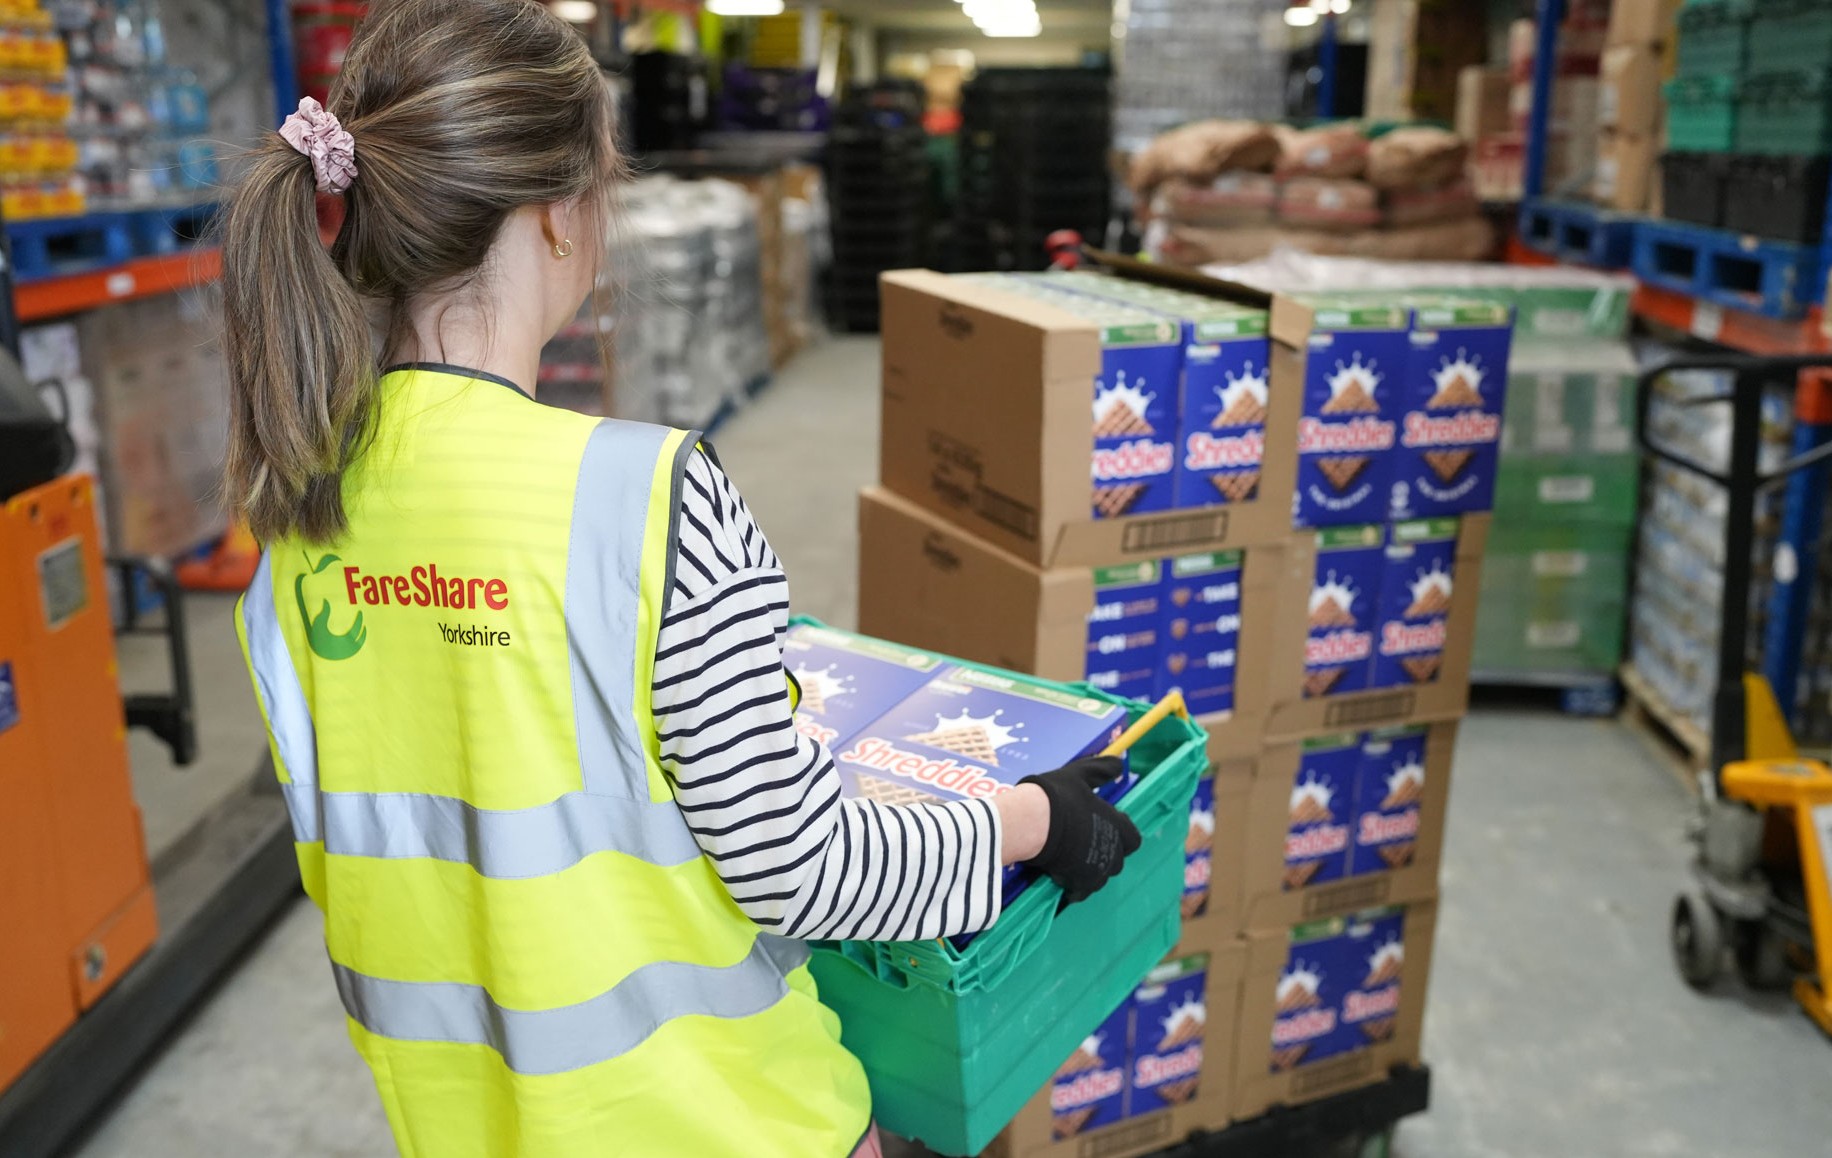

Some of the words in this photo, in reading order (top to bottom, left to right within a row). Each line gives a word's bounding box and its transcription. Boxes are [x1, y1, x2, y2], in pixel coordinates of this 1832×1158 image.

[1298, 416, 1396, 453] Shreddies
[1402, 411, 1499, 447] Shreddies
[344, 564, 509, 611] FareShare
[1086, 602, 1123, 621] AKE
[438, 622, 510, 646] Yorkshire
[841, 738, 1013, 799] Shreddies
